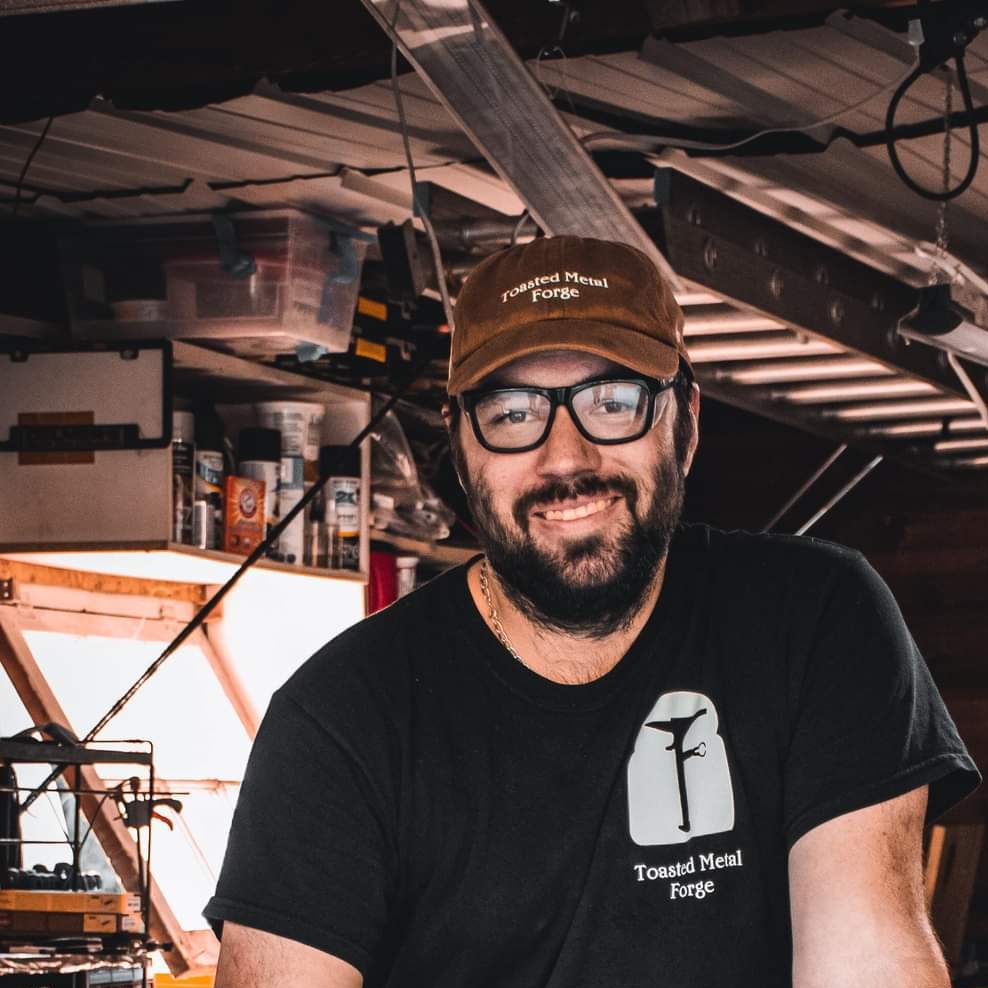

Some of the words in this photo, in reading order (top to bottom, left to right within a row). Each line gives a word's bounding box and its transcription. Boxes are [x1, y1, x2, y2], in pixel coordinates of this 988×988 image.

[501, 272, 561, 303] Toasted
[564, 271, 609, 289] Metal
[531, 287, 580, 303] Forge
[633, 856, 696, 882] Toasted
[698, 849, 743, 872] Metal
[670, 881, 715, 900] Forge
